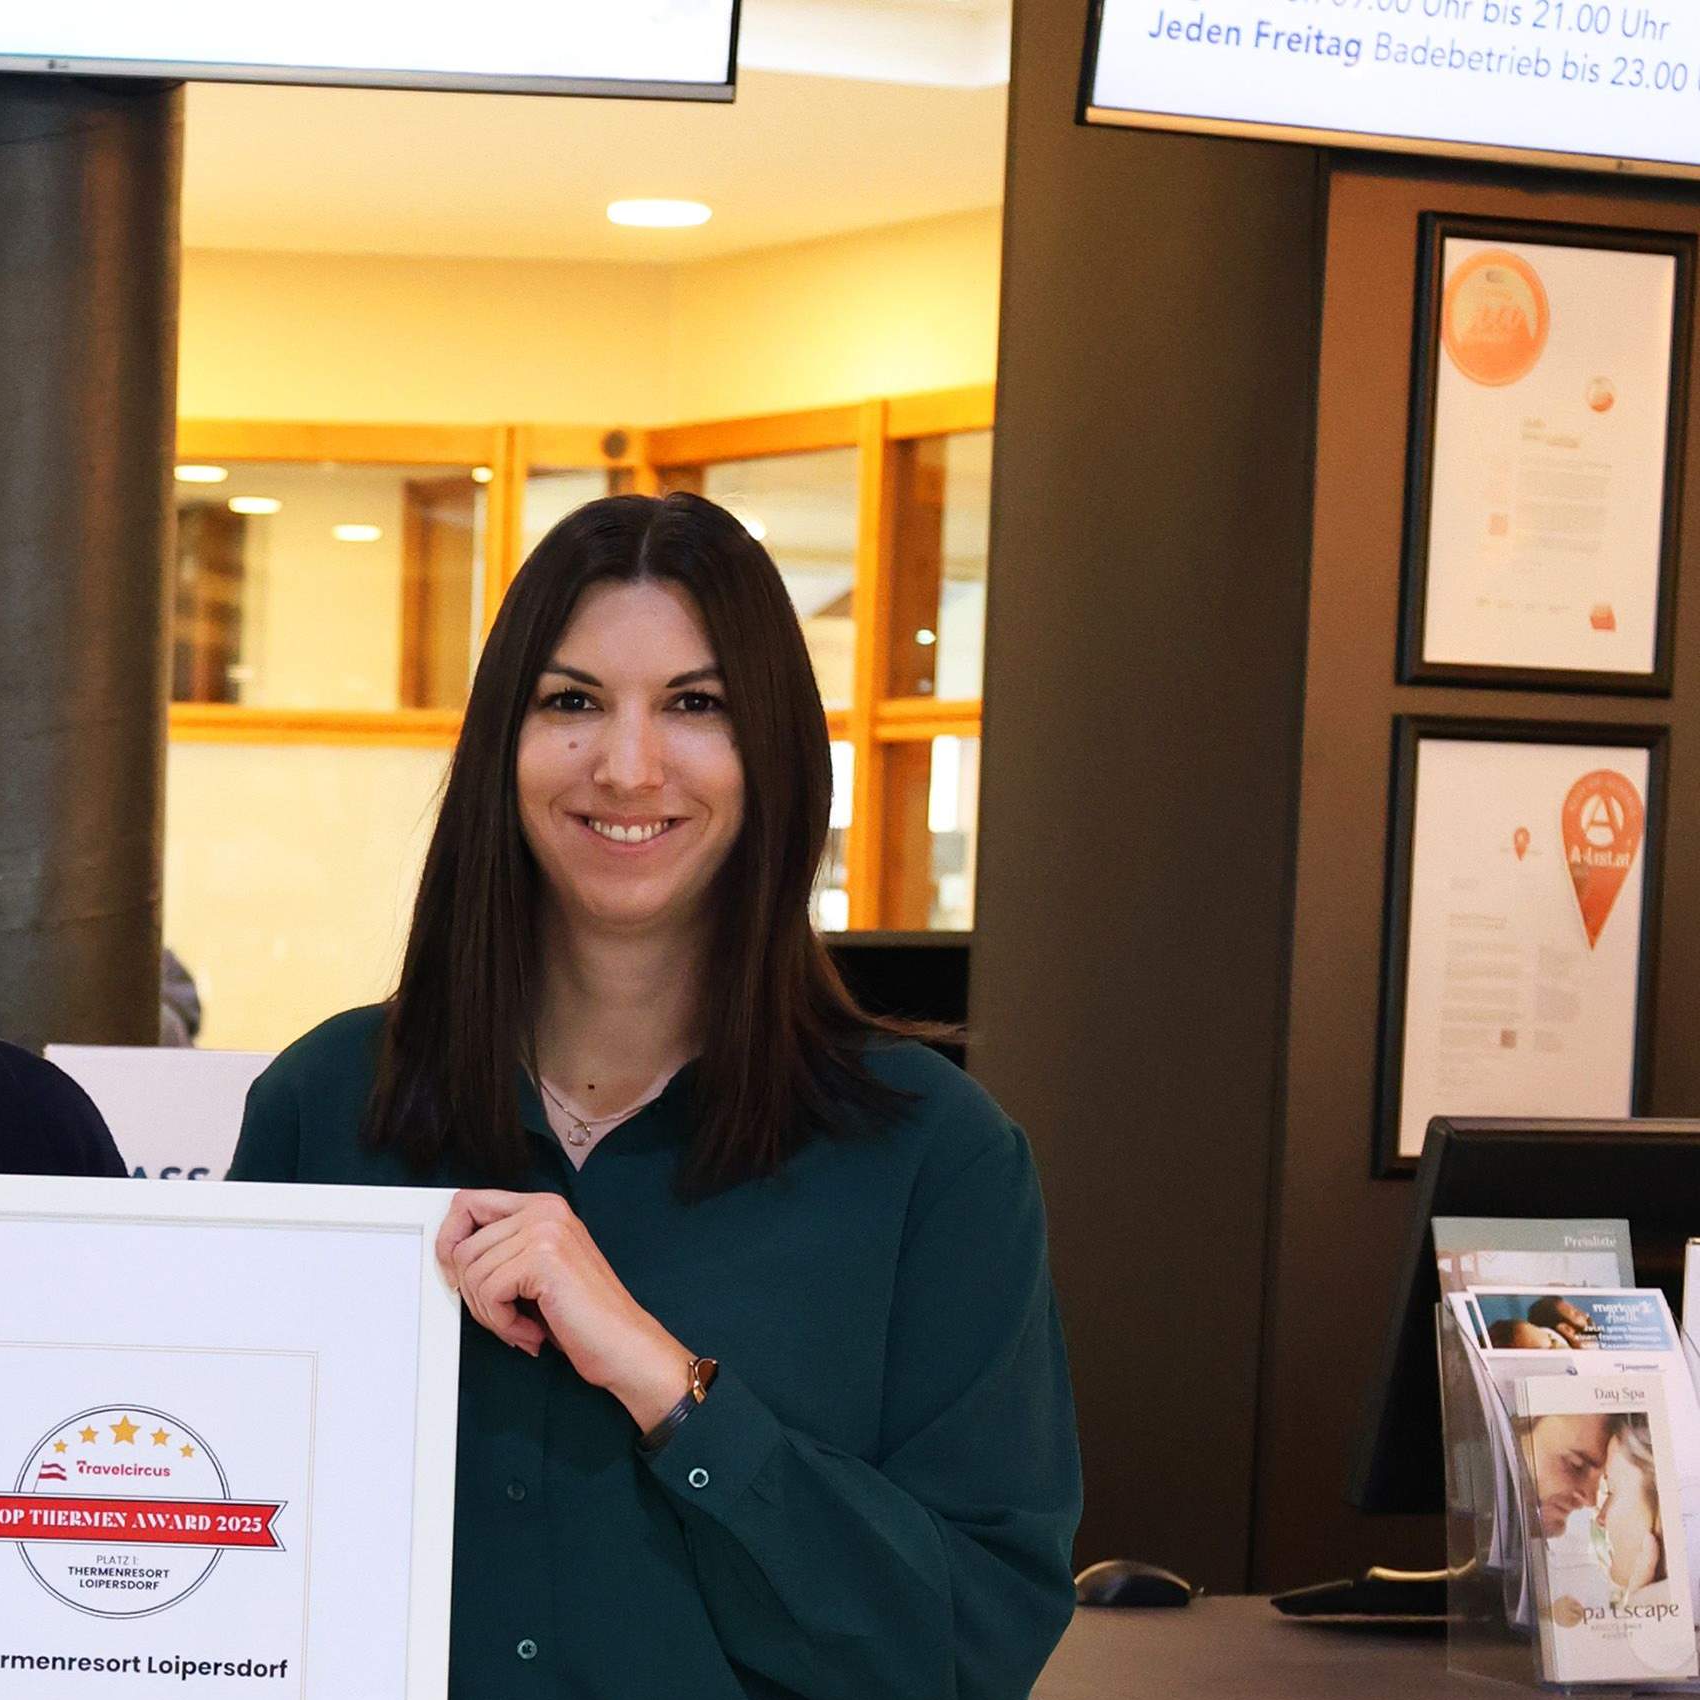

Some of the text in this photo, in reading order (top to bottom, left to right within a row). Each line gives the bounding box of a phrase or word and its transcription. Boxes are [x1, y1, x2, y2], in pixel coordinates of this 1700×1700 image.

[1532, 0, 1611, 35] 21.00
[1621, 8, 1671, 41] Uhr
[1148, 10, 1241, 46] Jeden
[1254, 20, 1362, 67] Freitag
[1374, 31, 1551, 78] Badebetrieb
[1562, 50, 1600, 83] bis
[1610, 56, 1688, 92] 23.00
[1594, 1387, 1646, 1403] Day Spa
[76, 1460, 172, 1478] Travelcircus
[29, 1509, 128, 1528] THERMEN
[131, 1512, 212, 1531] AWARD
[216, 1515, 263, 1533] 2025
[96, 1554, 130, 1566] PLATZ
[67, 1566, 170, 1579] THERMENRESORT
[79, 1579, 160, 1591] LOIPERSDORF
[147, 1655, 289, 1681] Loipersdorf
